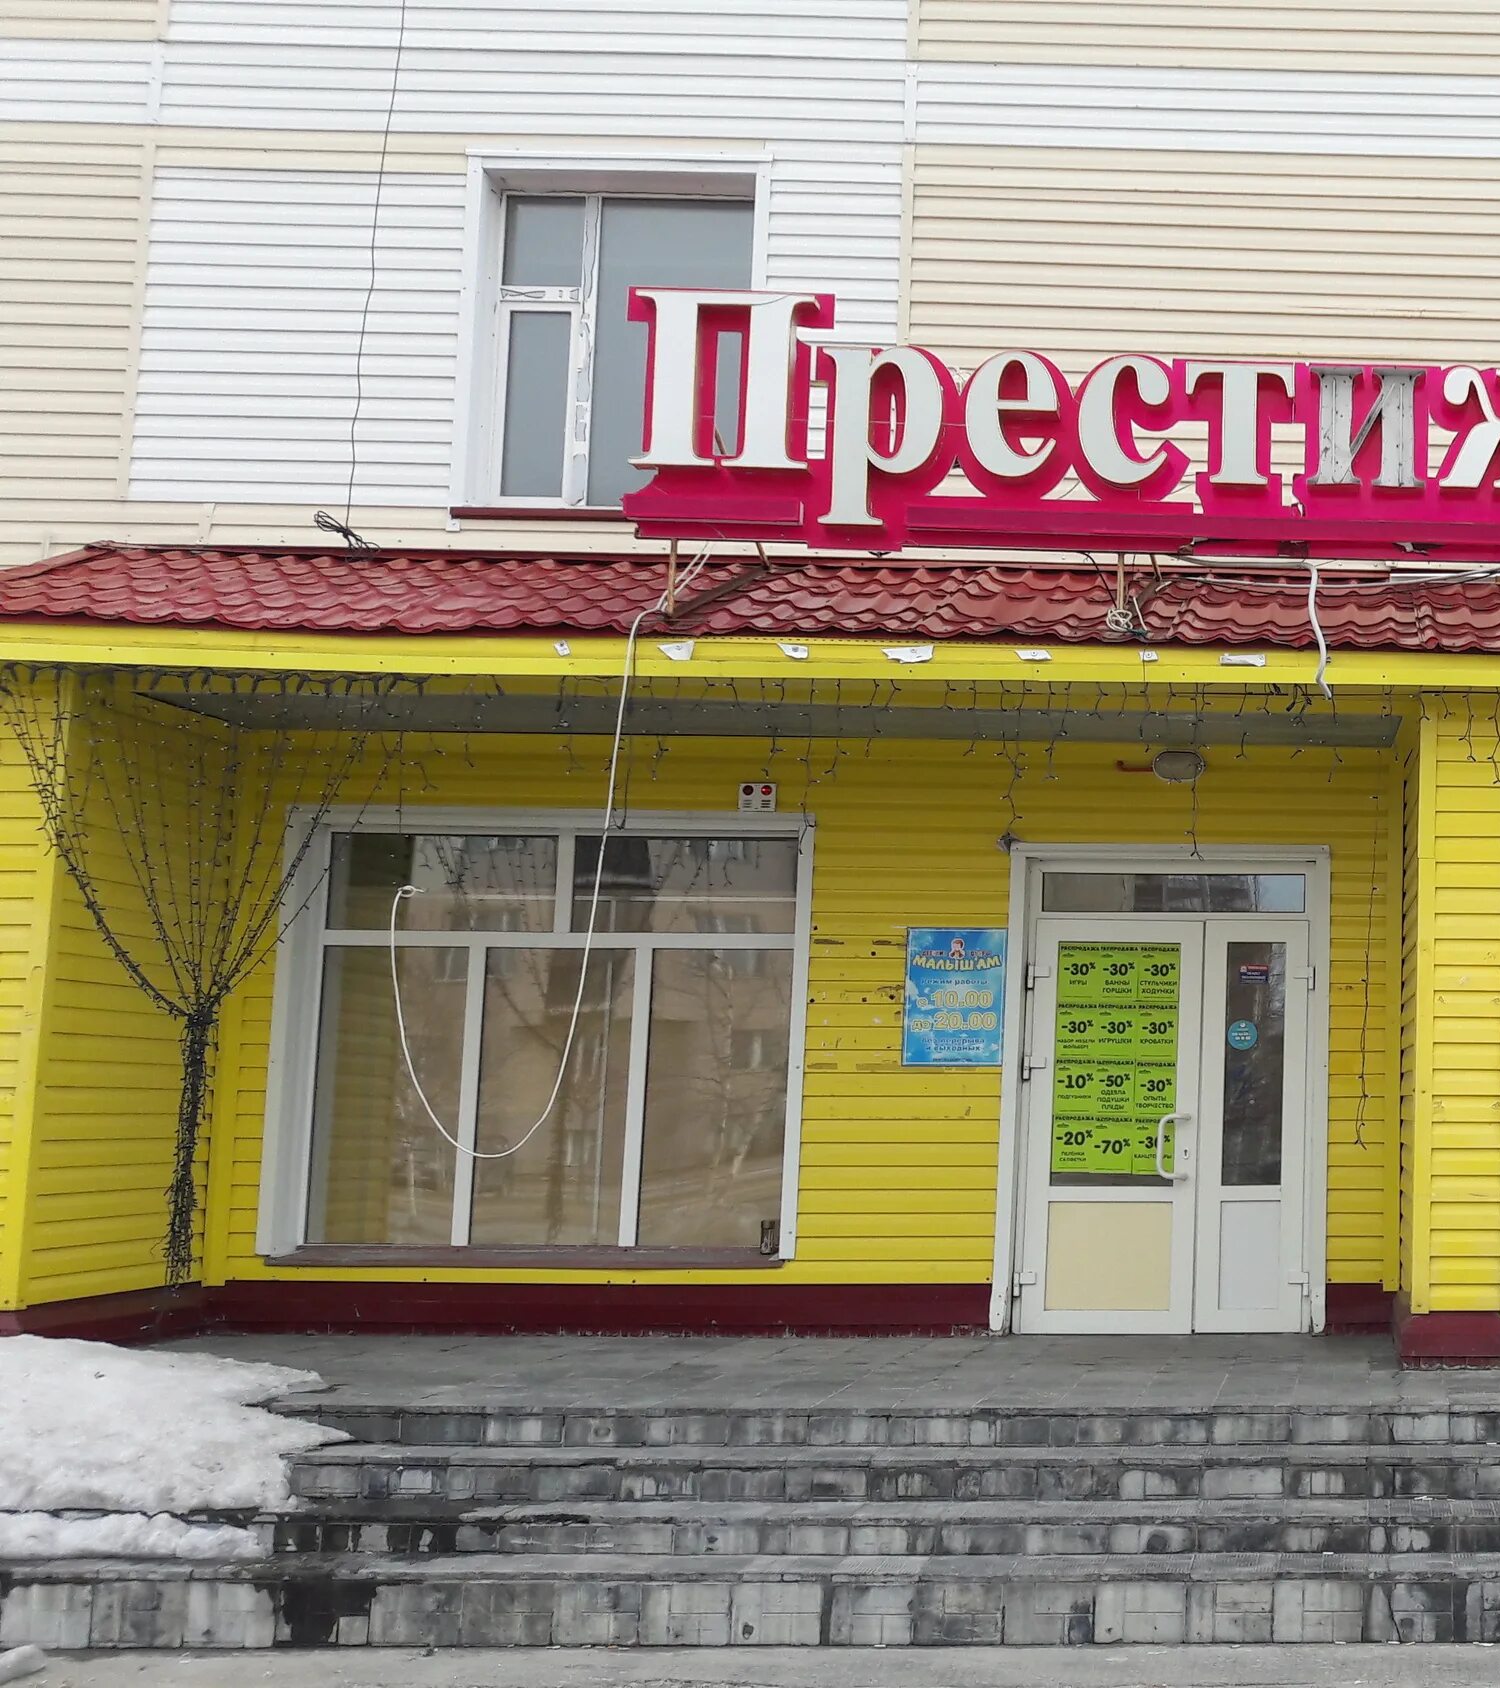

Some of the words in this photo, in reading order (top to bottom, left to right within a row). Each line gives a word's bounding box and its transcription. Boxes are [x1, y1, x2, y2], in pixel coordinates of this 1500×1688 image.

[1063, 961, 1096, 976] -30%
[1102, 961, 1136, 977] -30%
[1143, 962, 1177, 977] -30%
[931, 989, 994, 1009] 10.00
[933, 1010, 998, 1032] 20.00
[1061, 1019, 1094, 1034] -30%
[1100, 1019, 1134, 1035] -30%
[1141, 1020, 1175, 1035] -30%
[1057, 1072, 1095, 1089] -10%
[1098, 1073, 1131, 1088] -50%
[1140, 1078, 1173, 1093] -30%
[1056, 1129, 1094, 1146] -20%
[1094, 1138, 1131, 1155] -70%
